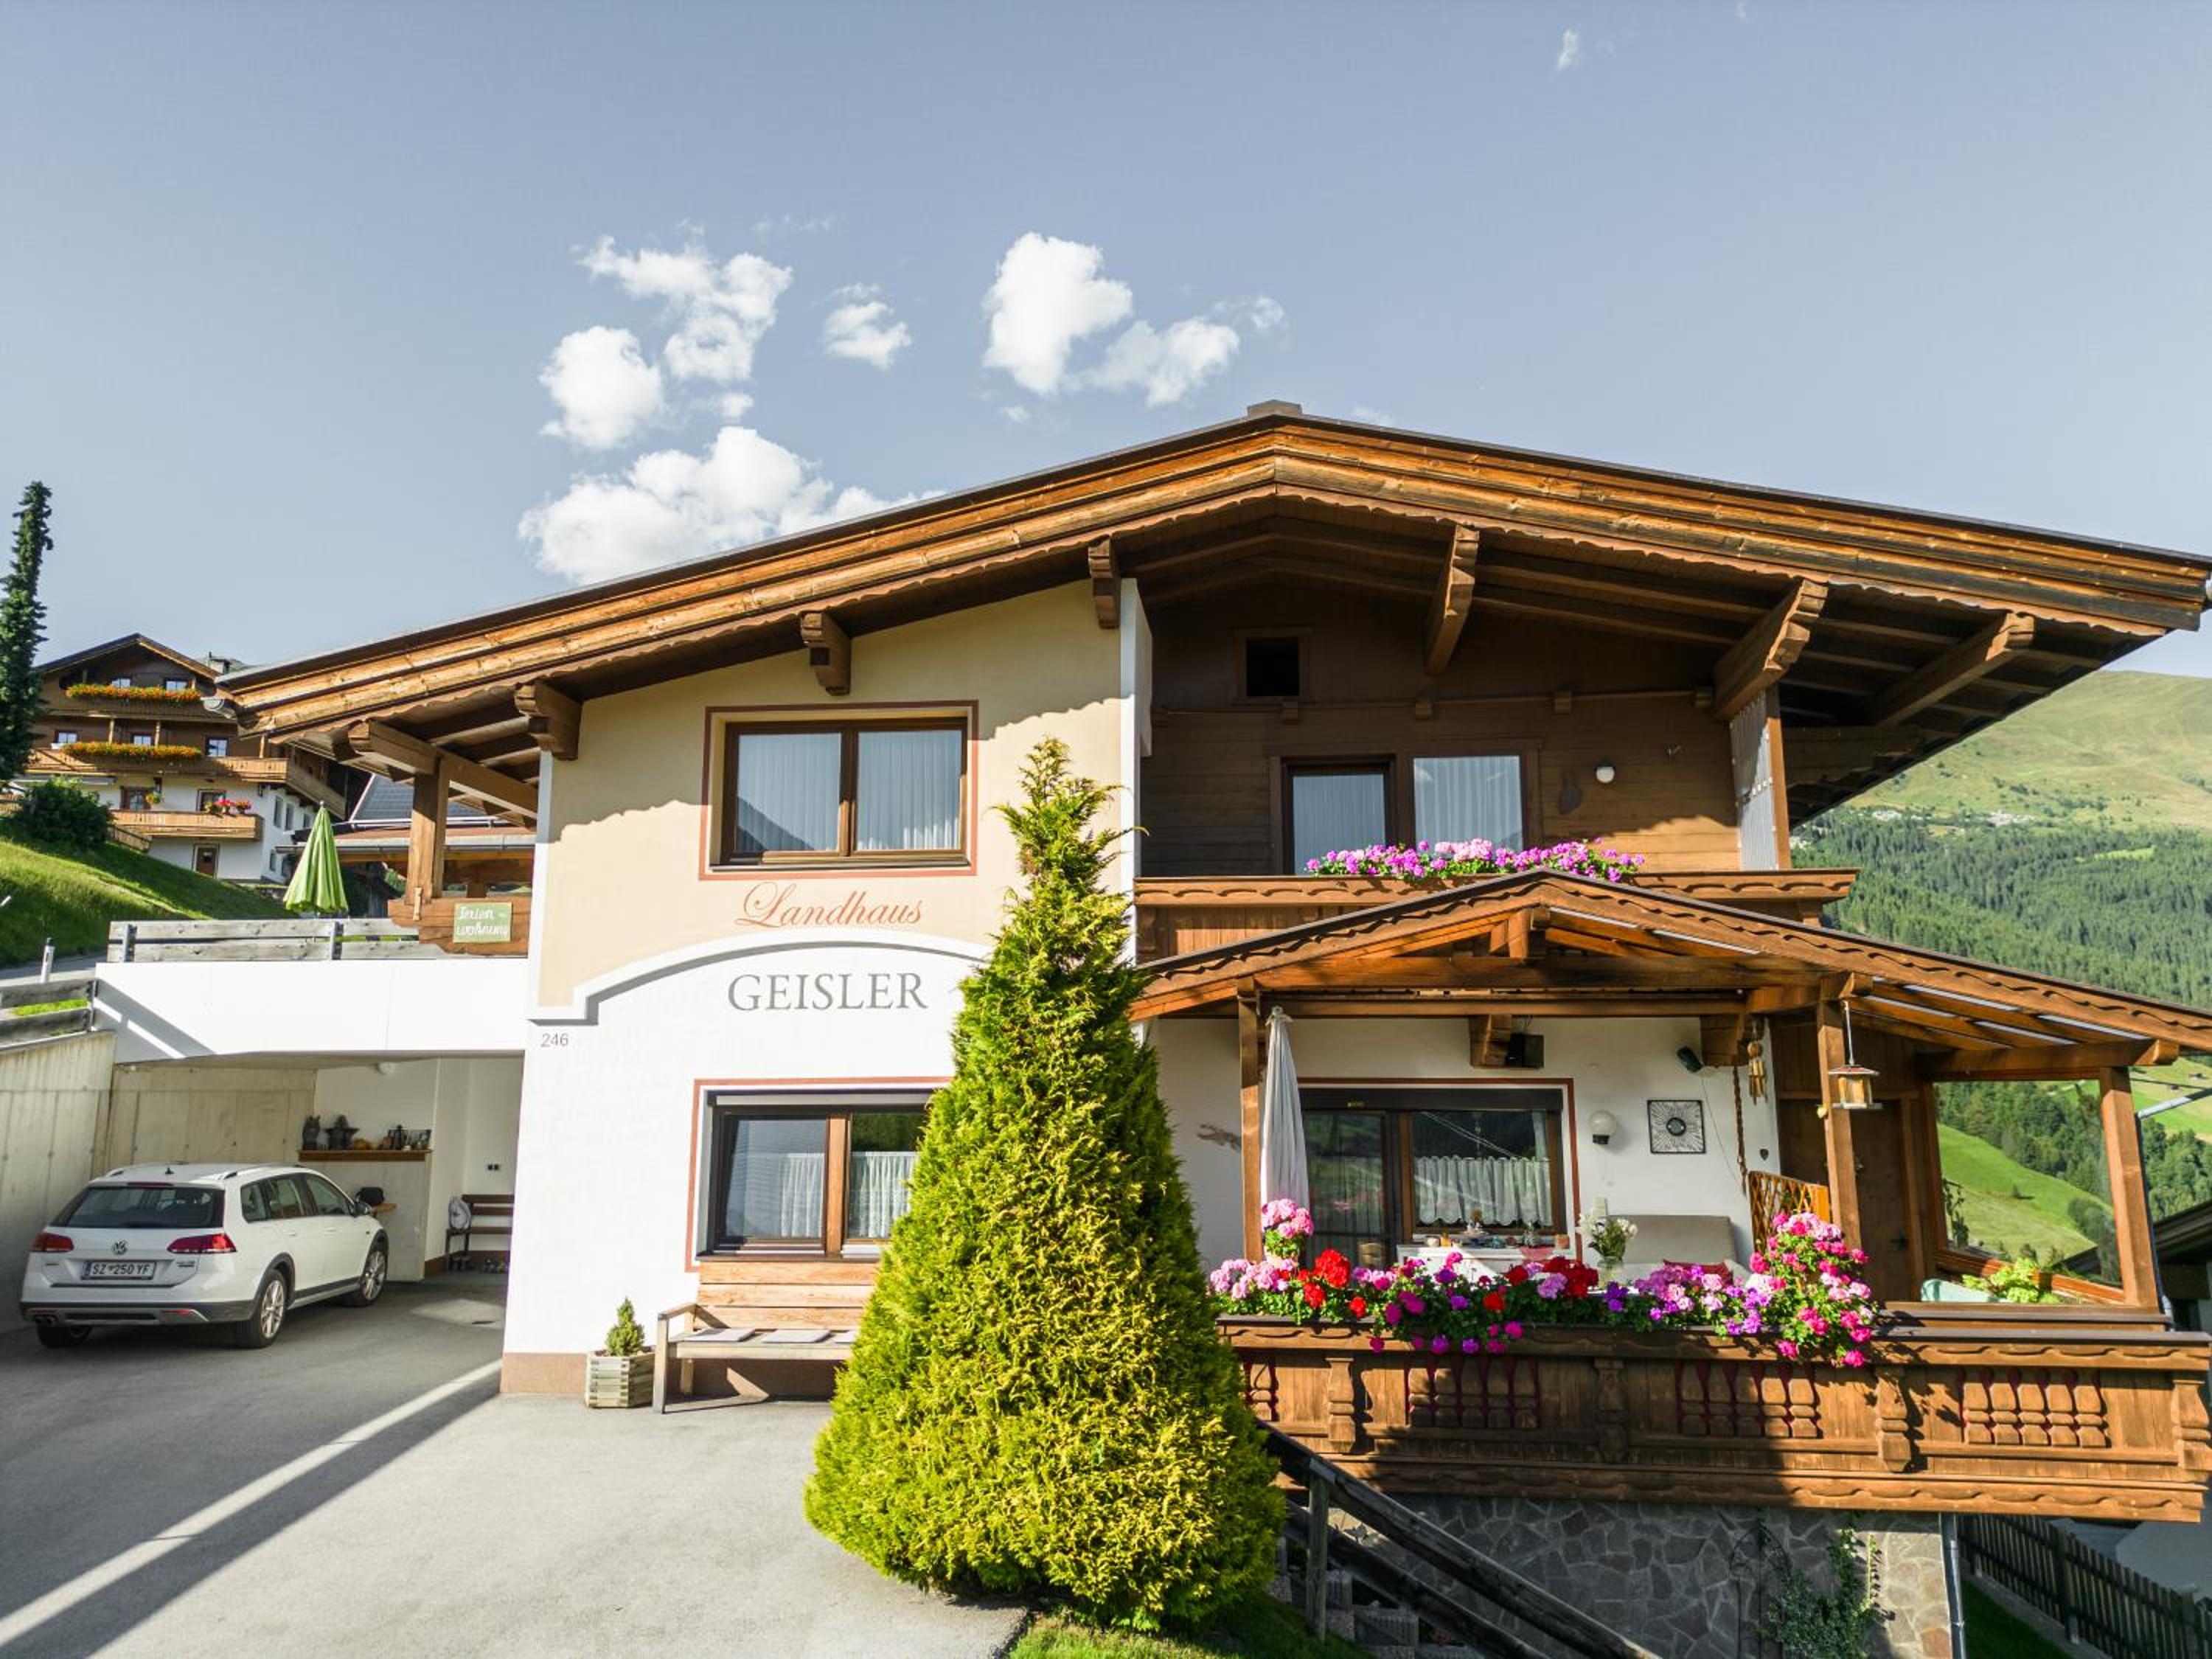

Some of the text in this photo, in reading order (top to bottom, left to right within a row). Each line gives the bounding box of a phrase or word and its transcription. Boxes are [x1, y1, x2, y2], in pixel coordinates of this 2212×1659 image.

[734, 880, 922, 928] Landhaus
[728, 973, 928, 1011] GEISLER
[541, 1033, 568, 1047] 246
[93, 1262, 150, 1275] SZ 250 YF
